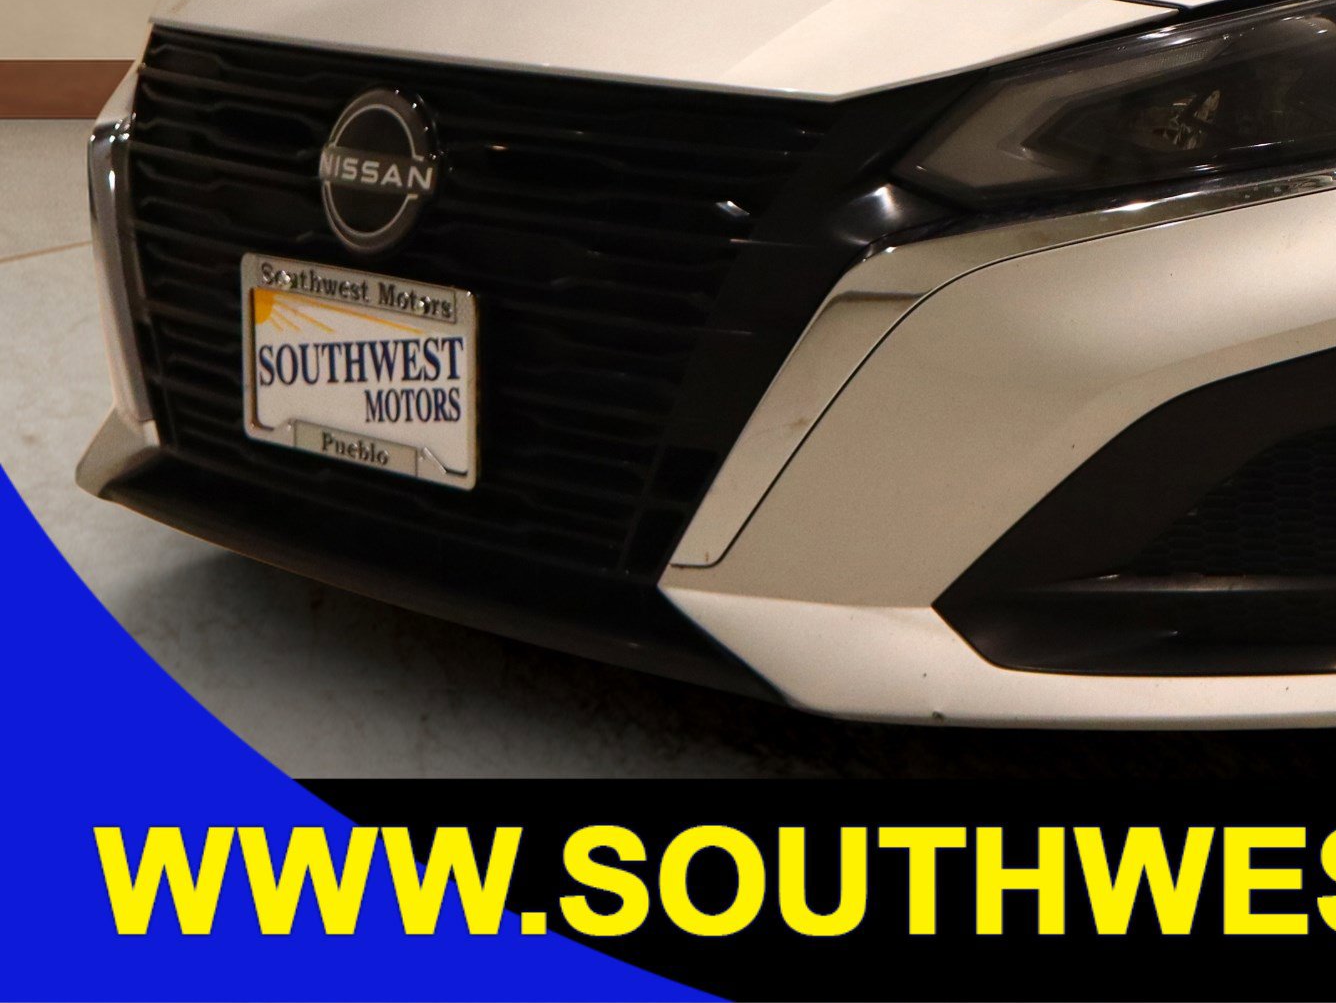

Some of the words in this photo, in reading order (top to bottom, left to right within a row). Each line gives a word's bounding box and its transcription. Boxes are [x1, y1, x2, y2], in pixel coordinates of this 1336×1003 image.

[320, 152, 433, 189] NISSAN
[258, 336, 464, 386] SOUTHWEST
[364, 387, 462, 423] MOTORS
[321, 432, 390, 466] Pueblo
